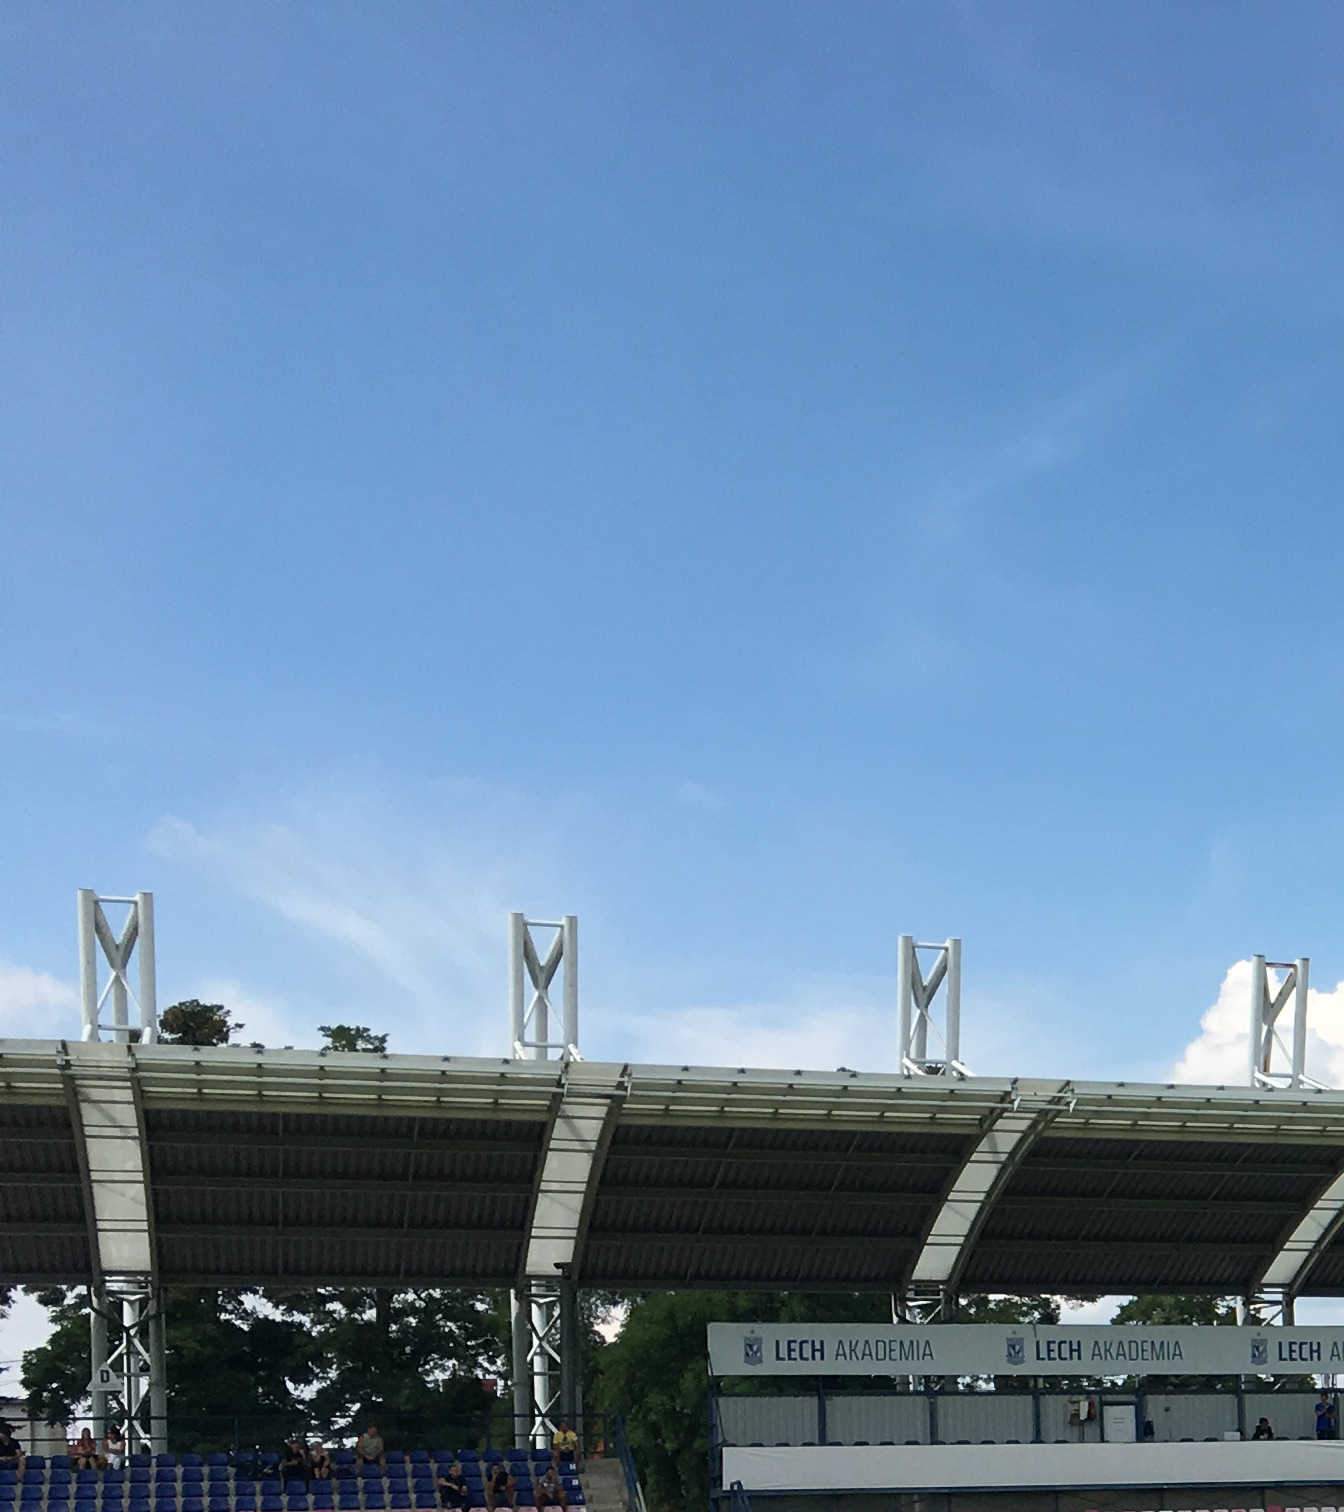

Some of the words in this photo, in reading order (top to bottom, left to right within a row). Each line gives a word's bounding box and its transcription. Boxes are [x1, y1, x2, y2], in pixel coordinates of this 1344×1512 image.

[775, 1339, 825, 1362] LECH
[834, 1339, 935, 1362] AKADEMIA
[1035, 1340, 1082, 1362] LECH
[1090, 1340, 1184, 1362] AKADEMIA
[1277, 1340, 1322, 1363] LECH
[100, 1369, 111, 1384] D
